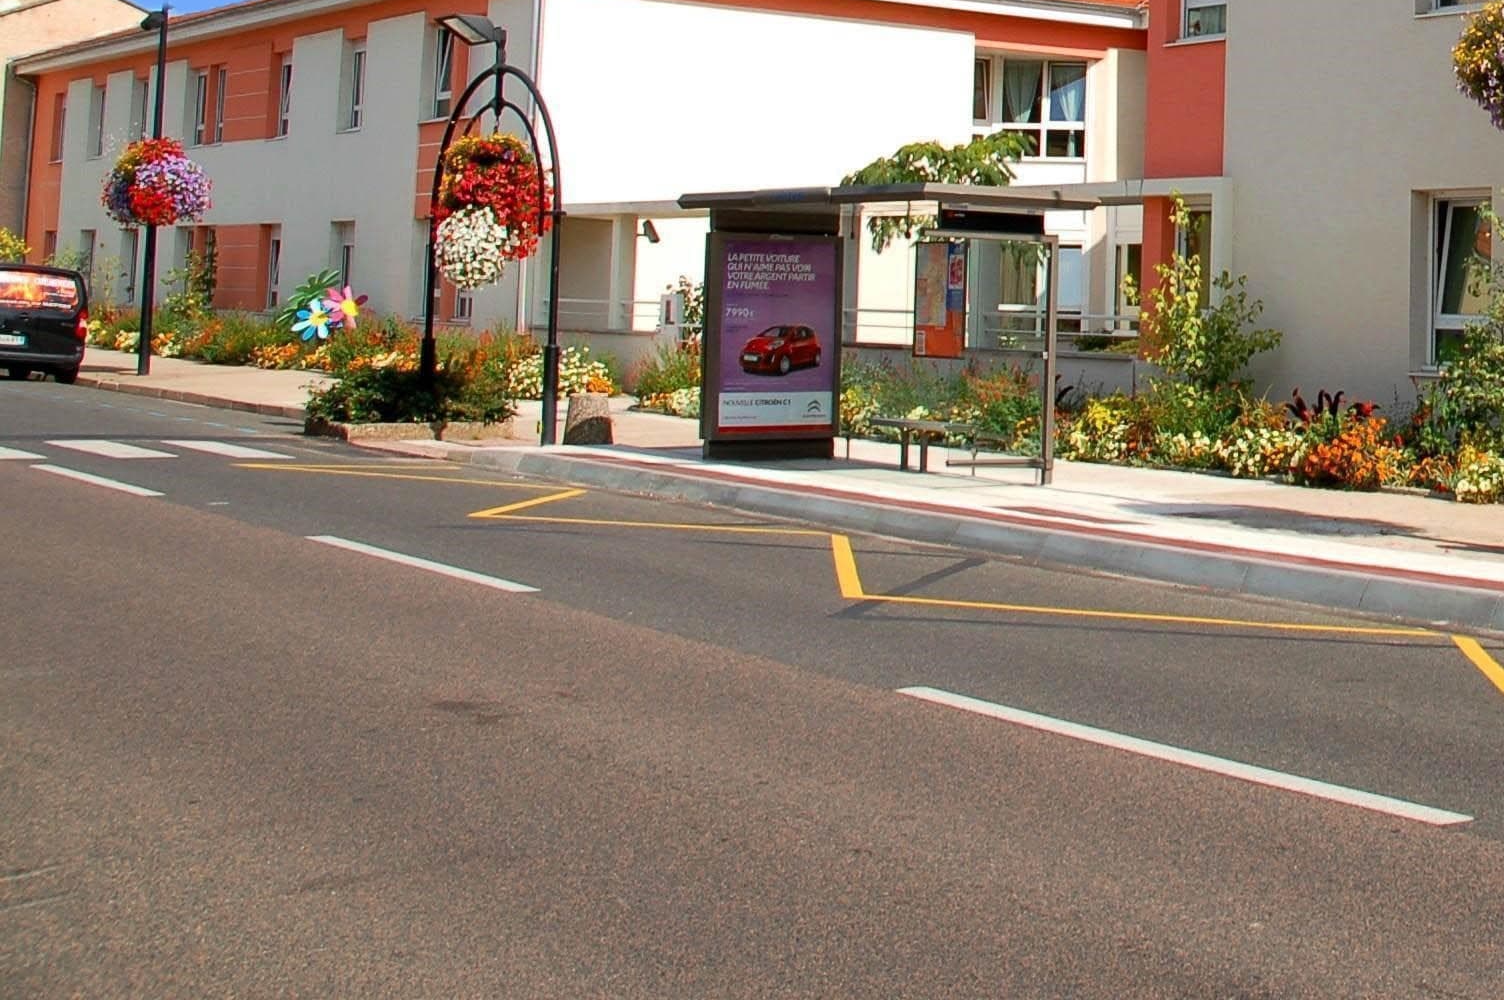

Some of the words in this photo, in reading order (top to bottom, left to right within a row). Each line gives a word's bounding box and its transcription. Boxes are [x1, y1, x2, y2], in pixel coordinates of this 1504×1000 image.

[728, 253, 738, 262] LA
[739, 253, 765, 263] PETITE
[766, 254, 800, 263] VOITURE
[728, 263, 743, 271] QUI
[775, 264, 791, 272] PAS
[792, 264, 812, 272] VOIR
[728, 272, 753, 280] VOTRE
[754, 272, 788, 281] ARGENT
[788, 273, 816, 281] PARTIR
[727, 281, 738, 289] EN
